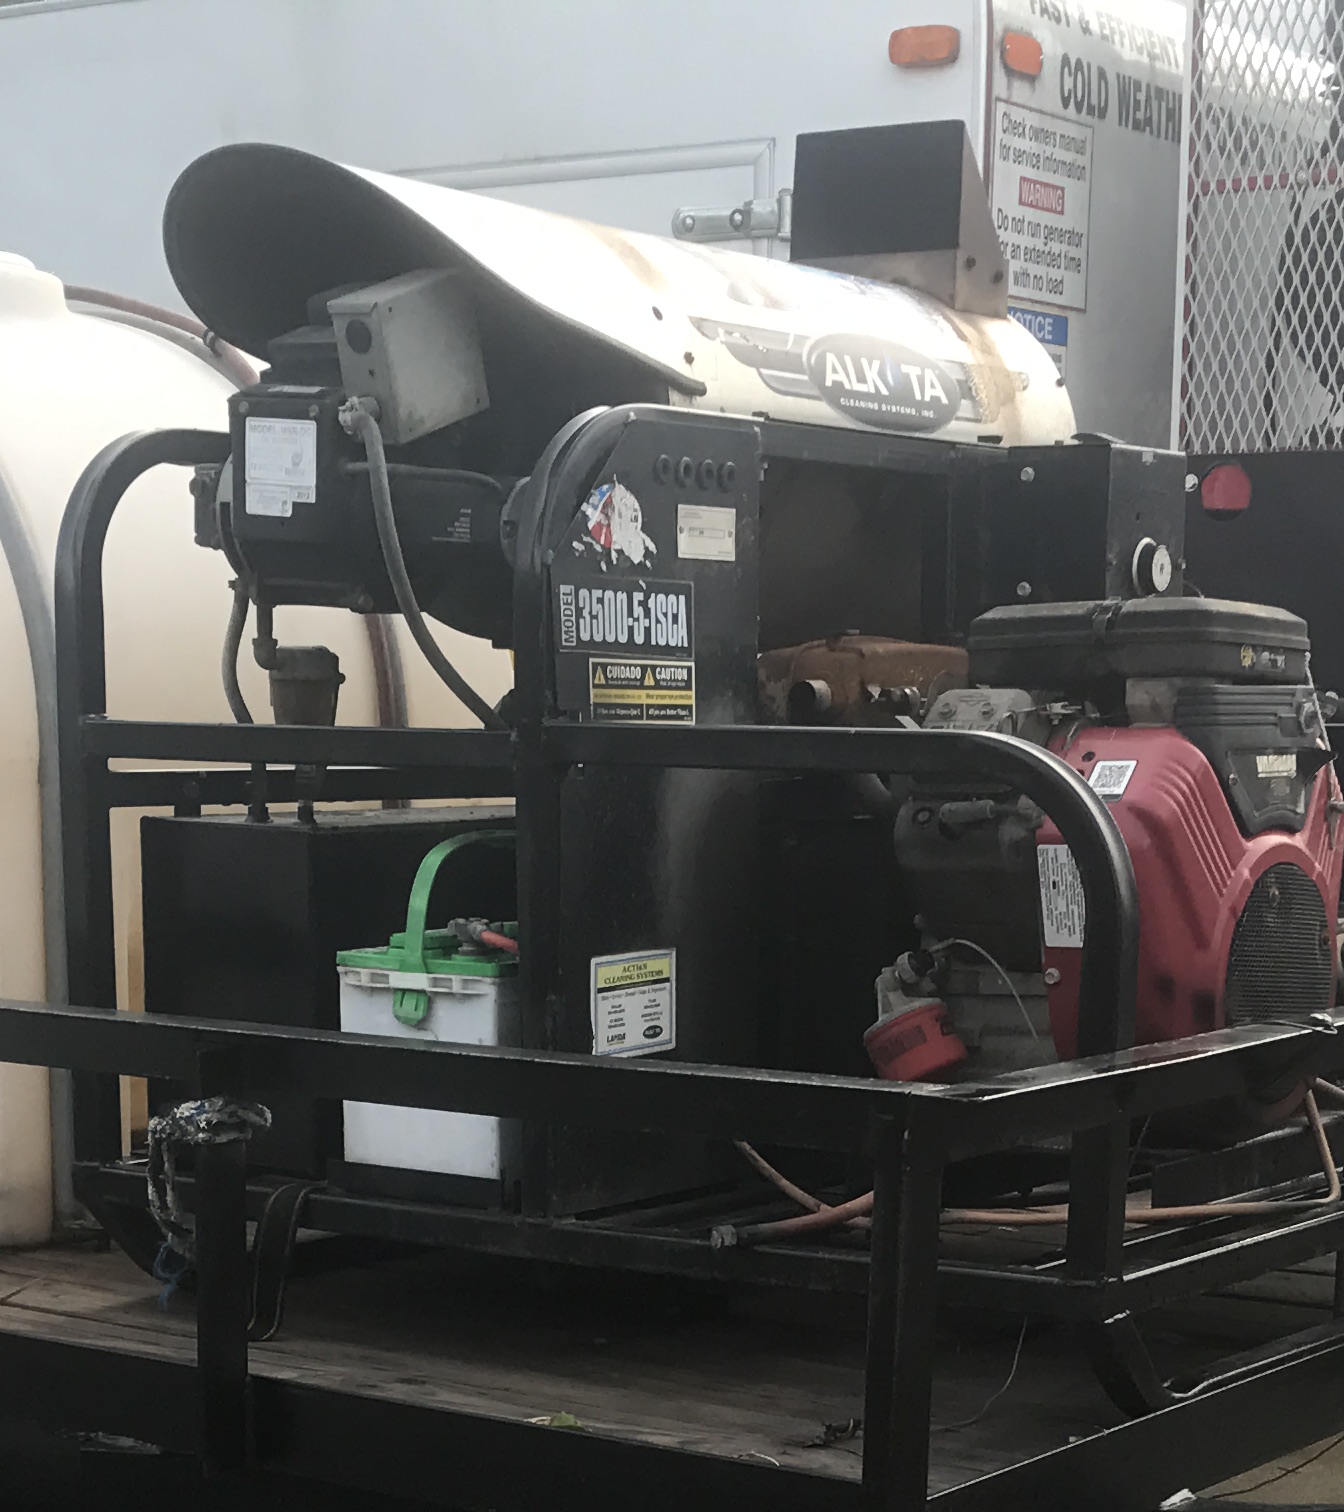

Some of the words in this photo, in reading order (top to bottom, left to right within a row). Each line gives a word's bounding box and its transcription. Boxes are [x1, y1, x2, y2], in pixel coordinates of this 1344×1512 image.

[1096, 10, 1180, 69] EFFICIENT
[1060, 53, 1110, 120] COLD
[1001, 110, 1027, 140] Check
[1028, 124, 1057, 148] owners
[1058, 132, 1088, 156] manual
[999, 137, 1011, 162] for
[1012, 146, 1041, 170] service
[1042, 149, 1087, 182] information
[1020, 179, 1064, 212] WARNING
[996, 208, 1009, 231] Do
[1011, 215, 1025, 236] not
[1026, 220, 1042, 240] run
[1043, 222, 1084, 249] generator
[1010, 242, 1022, 260] an
[1023, 244, 1062, 270] extended
[1063, 250, 1082, 274] time
[1013, 266, 1031, 287] with
[1032, 274, 1044, 292] no
[1045, 271, 1064, 295] load
[1010, 312, 1054, 340] OTICE
[825, 352, 949, 404] ALKTA
[840, 397, 879, 411] CLEANING
[562, 588, 574, 644] MODEL
[578, 588, 689, 648] 3500-5-1SCA
[607, 666, 642, 680] CUIDADO
[656, 667, 688, 681] CAUTION
[636, 969, 664, 980] SYSTEMS
